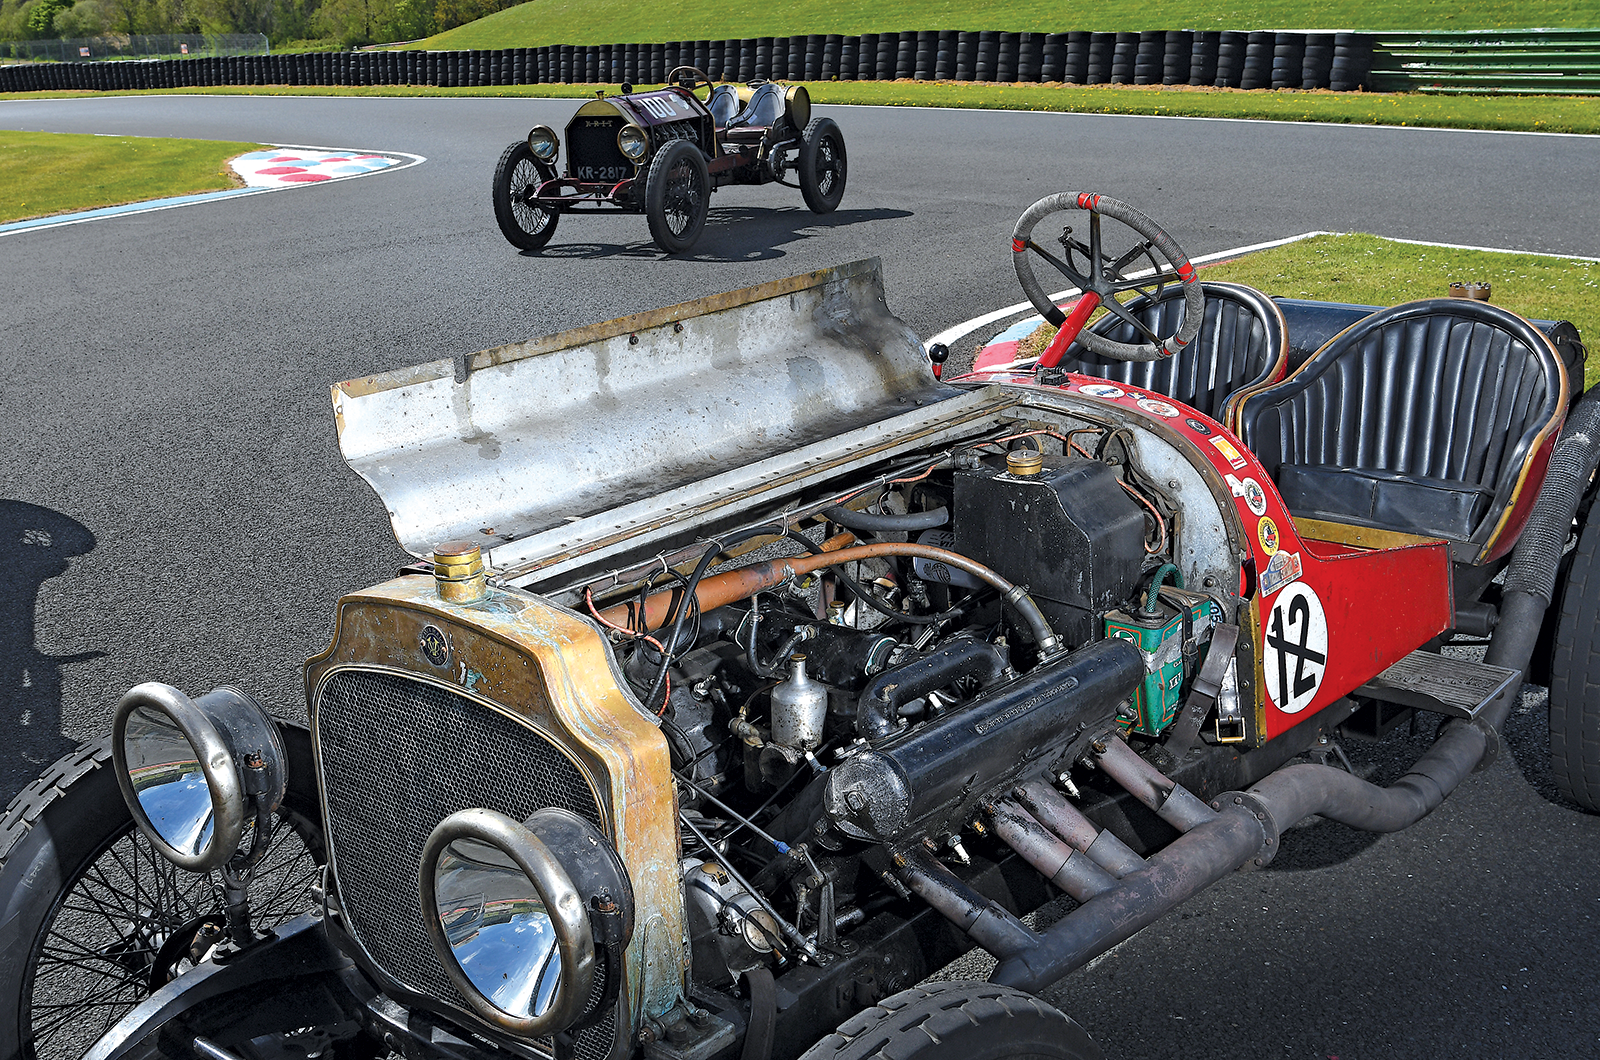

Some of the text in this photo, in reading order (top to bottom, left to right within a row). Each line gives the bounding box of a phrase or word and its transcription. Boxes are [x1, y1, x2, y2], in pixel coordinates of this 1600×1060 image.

[637, 96, 677, 119] 100
[577, 166, 627, 179] KR-2817
[1268, 593, 1322, 708] 12
